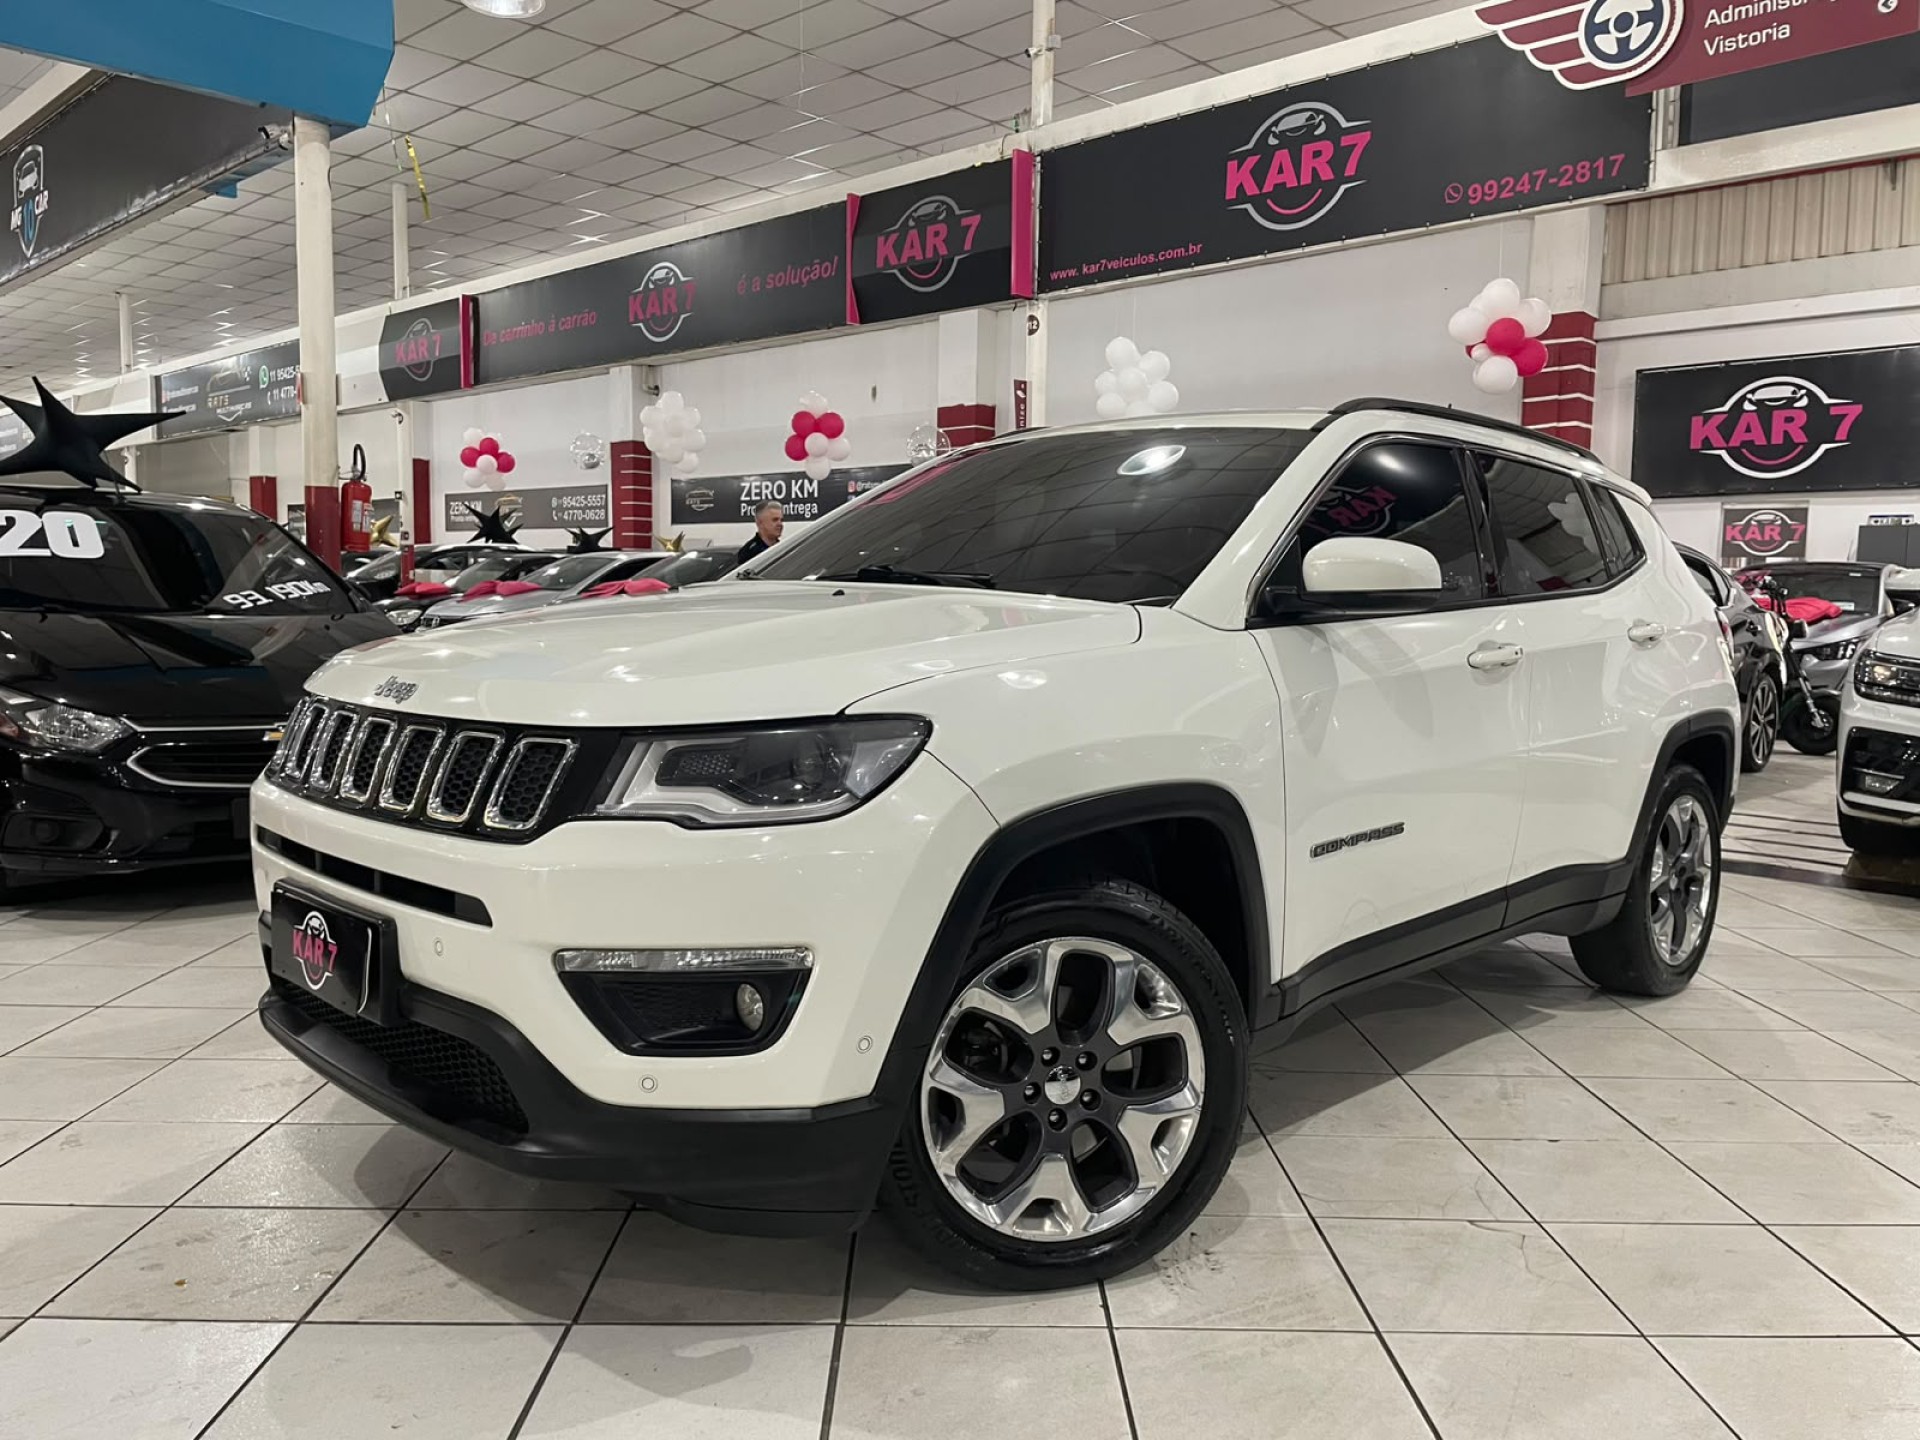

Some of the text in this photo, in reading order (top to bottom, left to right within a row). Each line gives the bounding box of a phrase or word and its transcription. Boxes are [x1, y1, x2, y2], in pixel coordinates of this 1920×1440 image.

[1704, 23, 1791, 56] Vistoria
[1468, 154, 1625, 204] 99247-2817
[876, 214, 981, 269] KAR 7
[752, 276, 760, 293] a
[766, 255, 838, 288] solução!
[1050, 267, 1079, 280] www.
[629, 281, 697, 323] KAR 7
[500, 320, 545, 342] carrinho
[559, 309, 597, 331] carrão
[395, 333, 442, 365] KAR 7
[1690, 404, 1863, 449] KAR 7
[740, 479, 818, 500] ZERO KM
[563, 509, 606, 520] 4770-0628
[783, 501, 818, 518] ntrega
[1726, 524, 1806, 541] KAR 7
[374, 676, 419, 704] Jeep
[1309, 821, 1405, 859] COMPASS
[293, 928, 338, 973] KAR 7
